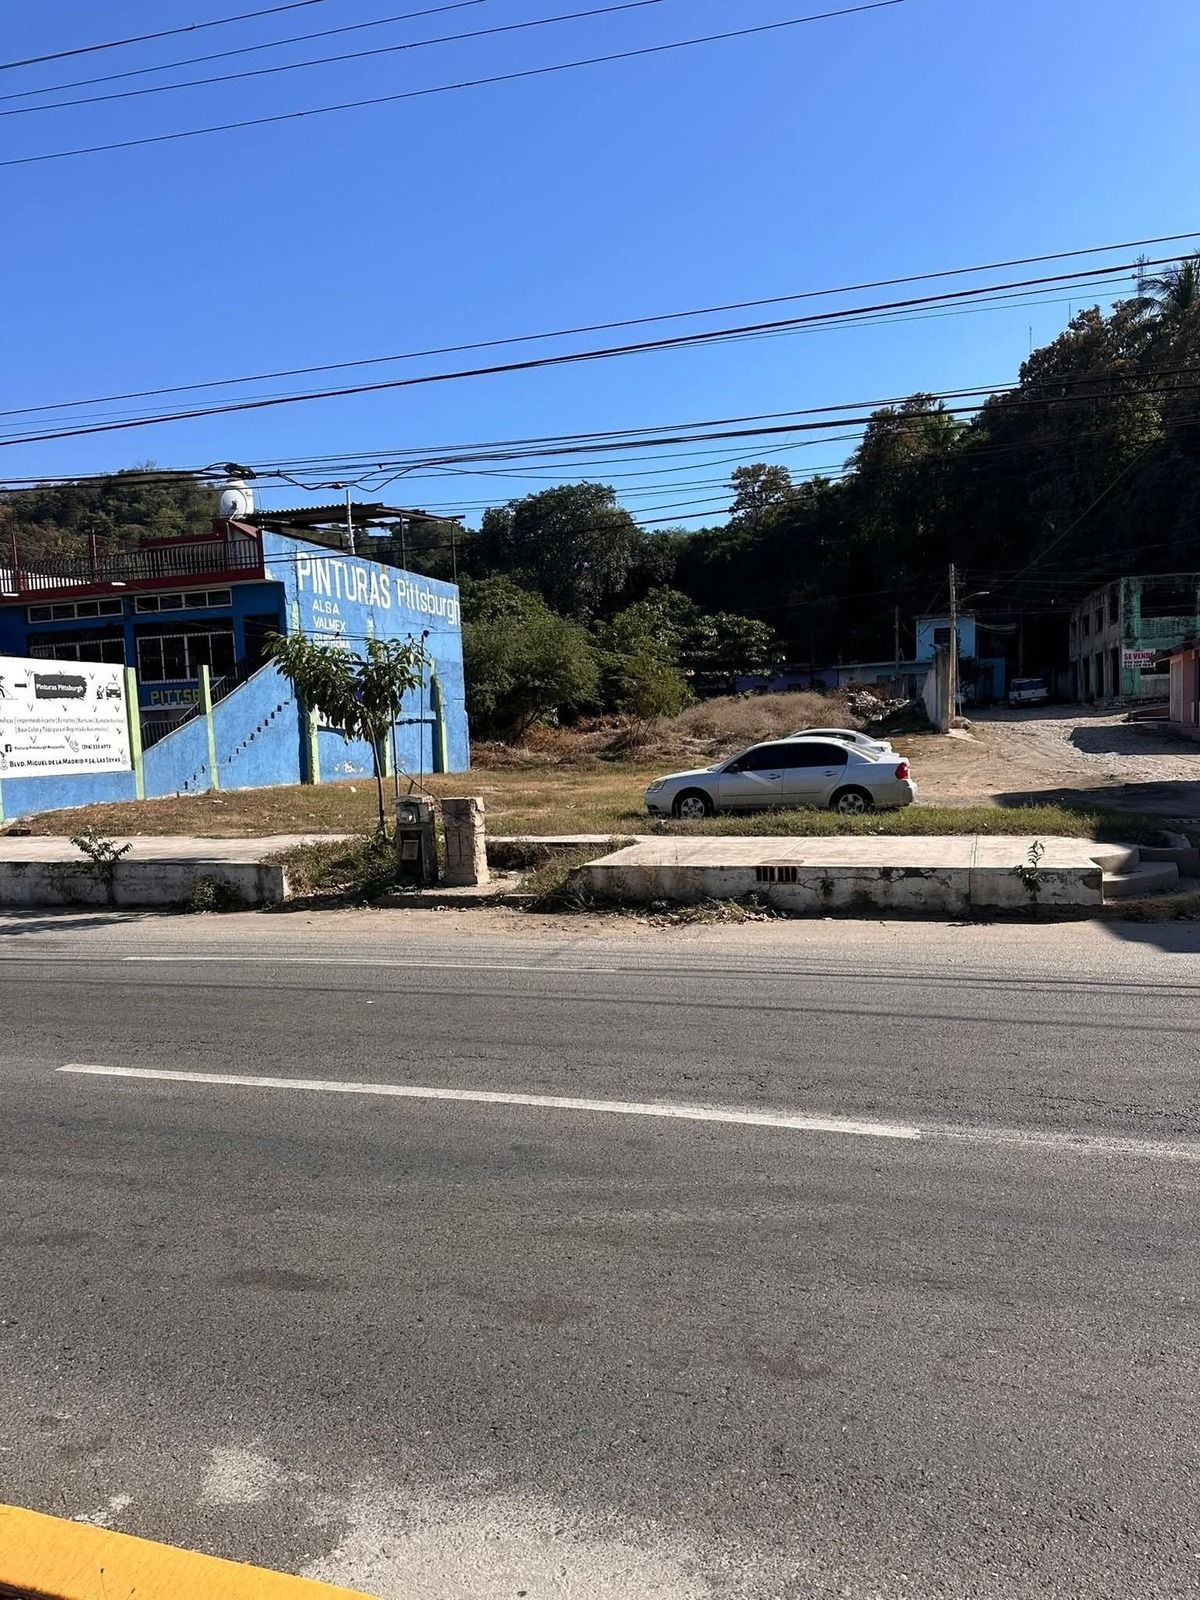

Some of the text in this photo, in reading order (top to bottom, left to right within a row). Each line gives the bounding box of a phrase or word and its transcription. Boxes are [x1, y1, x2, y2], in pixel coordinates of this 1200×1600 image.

[297, 552, 460, 626] PINTURAS Pittsburgh
[313, 599, 340, 615] ALSA
[313, 616, 346, 632] VALMEX
[1124, 652, 1132, 660] SE
[57, 684, 84, 693] Pittsburgh
